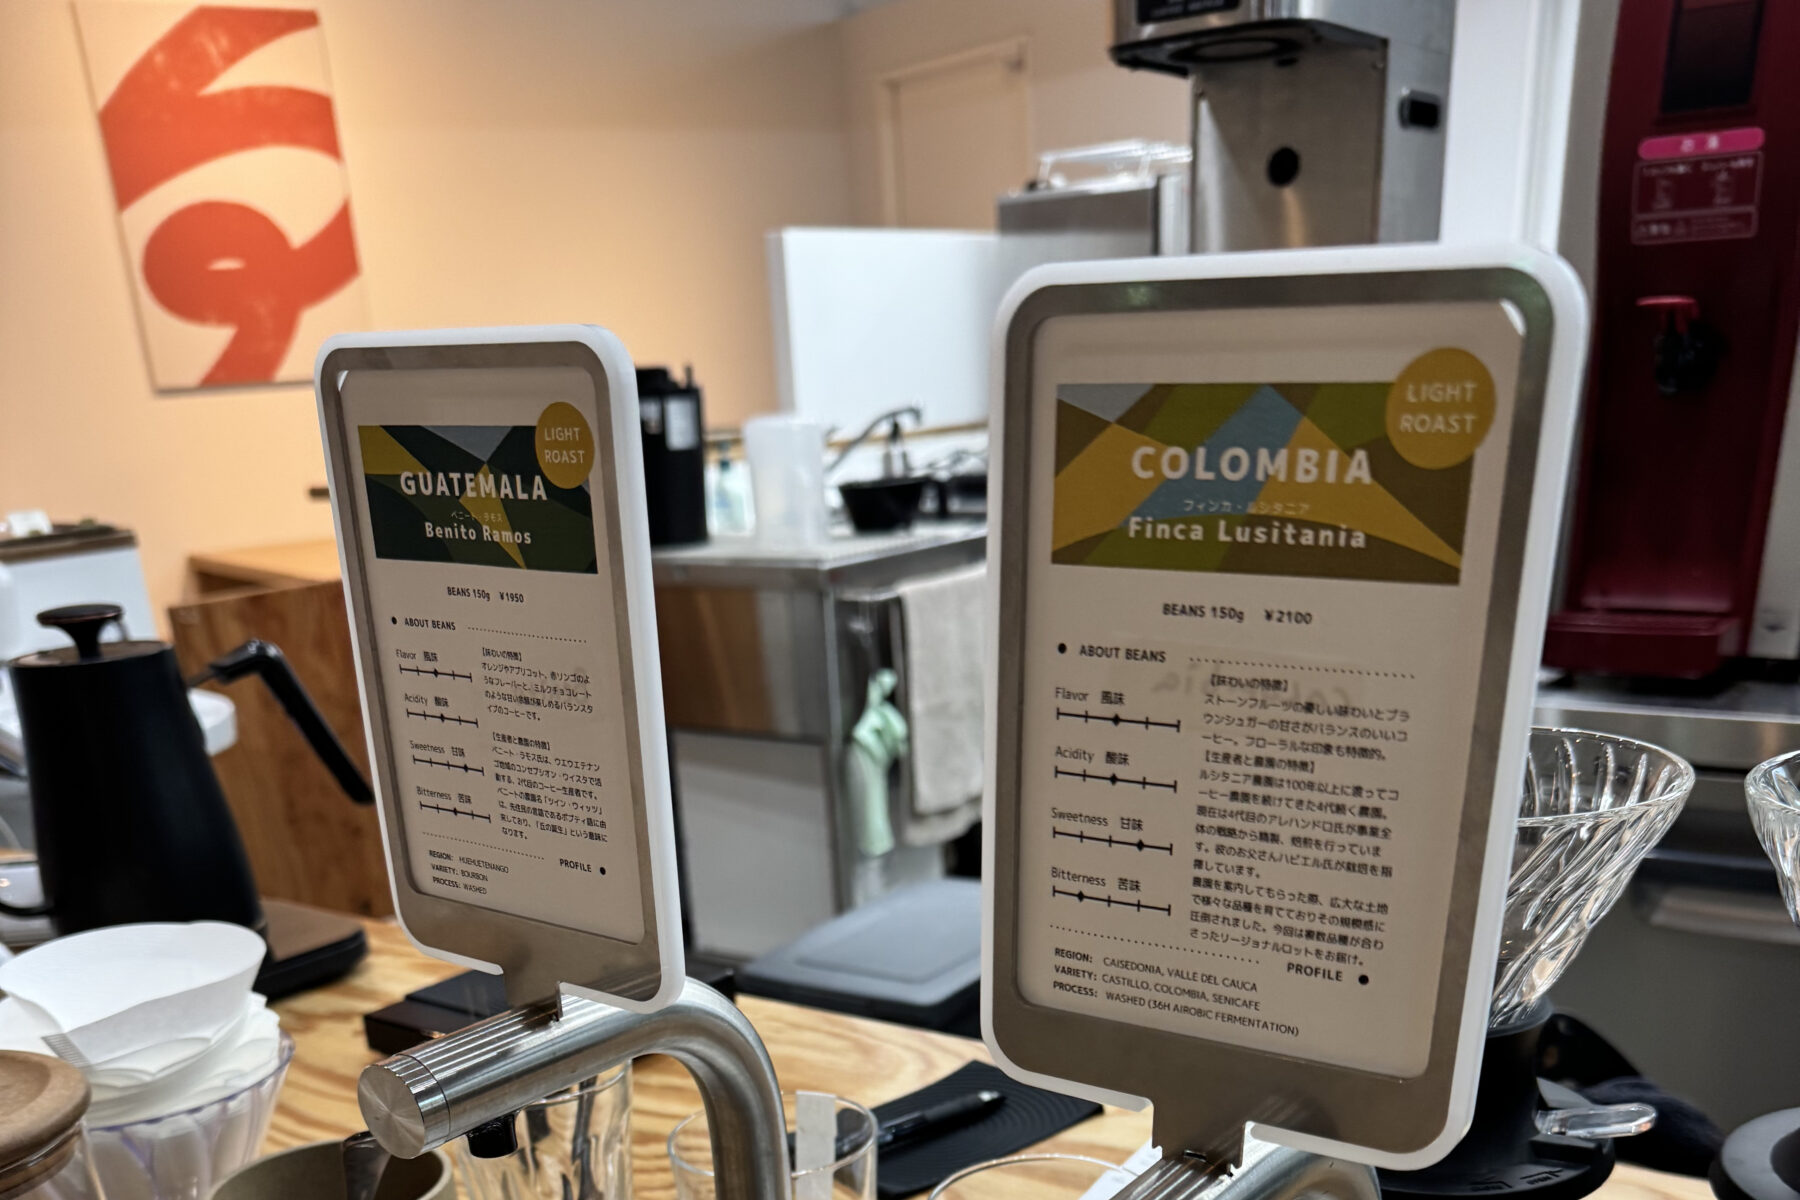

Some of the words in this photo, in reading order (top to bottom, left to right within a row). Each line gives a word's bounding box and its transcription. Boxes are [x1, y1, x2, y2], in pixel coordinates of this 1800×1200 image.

[1406, 382, 1477, 404] LIGHT
[544, 427, 580, 441] LIGHT
[1400, 414, 1477, 434] ROAST
[544, 449, 585, 464] ROAST
[1131, 446, 1373, 484] COLOMBIA
[400, 471, 548, 500] GUATEMALA
[425, 521, 477, 540] Benito
[482, 525, 532, 544] Ramos
[1128, 516, 1204, 541] Finca
[1218, 519, 1367, 548] Lusitania
[447, 586, 471, 597] BEANS
[472, 589, 490, 602] 150g
[499, 591, 525, 603] ¥1950
[404, 617, 429, 628] ABOUT
[431, 619, 456, 631] BEANS
[1162, 603, 1206, 617] BEANS
[1210, 606, 1245, 624] 150g
[1264, 608, 1313, 625] ¥2100
[395, 648, 417, 660] Flavor
[1079, 644, 1121, 658] ABOUT
[1125, 648, 1167, 663] BEANS
[404, 693, 428, 706] Acidity
[1055, 687, 1089, 702] Flavor
[1100, 690, 1126, 706] 風味
[409, 740, 446, 754] Sweetness
[1055, 746, 1095, 763] Acidity
[1105, 751, 1130, 766] 酸味
[416, 786, 452, 801] Bitterness
[1051, 807, 1109, 827] Sweetness
[1120, 816, 1144, 832] 甘味
[429, 850, 453, 861] REGION:
[459, 856, 509, 873] HUEHUETENANGO
[559, 858, 592, 873] PROFILE
[431, 863, 459, 875] VARIETY:
[461, 869, 489, 882] BOURBON
[1051, 866, 1106, 887] Bitterness
[1117, 877, 1142, 893] 苦味
[432, 876, 461, 889] PROCESS:
[463, 883, 488, 895] WASHED
[1054, 948, 1093, 964] REGION:
[1103, 957, 1164, 977] CAISEDONIA,
[1167, 967, 1199, 982] VALLE
[1200, 973, 1220, 986] DEL
[1221, 978, 1258, 993] CAUCA
[1287, 962, 1343, 982] PROFILE
[1054, 964, 1097, 981] VARIETY:
[1102, 973, 1152, 992] CASTILLO,
[1154, 983, 1209, 1002] COLOMBIA,
[1212, 993, 1260, 1011] SENICAFE
[1053, 981, 1098, 998] PROCESS:
[1105, 991, 1146, 1008] WASHED
[1147, 997, 1171, 1012] (36H
[1173, 1003, 1213, 1020] AIROBIC
[1215, 1011, 1300, 1037] FERMENTATION)
